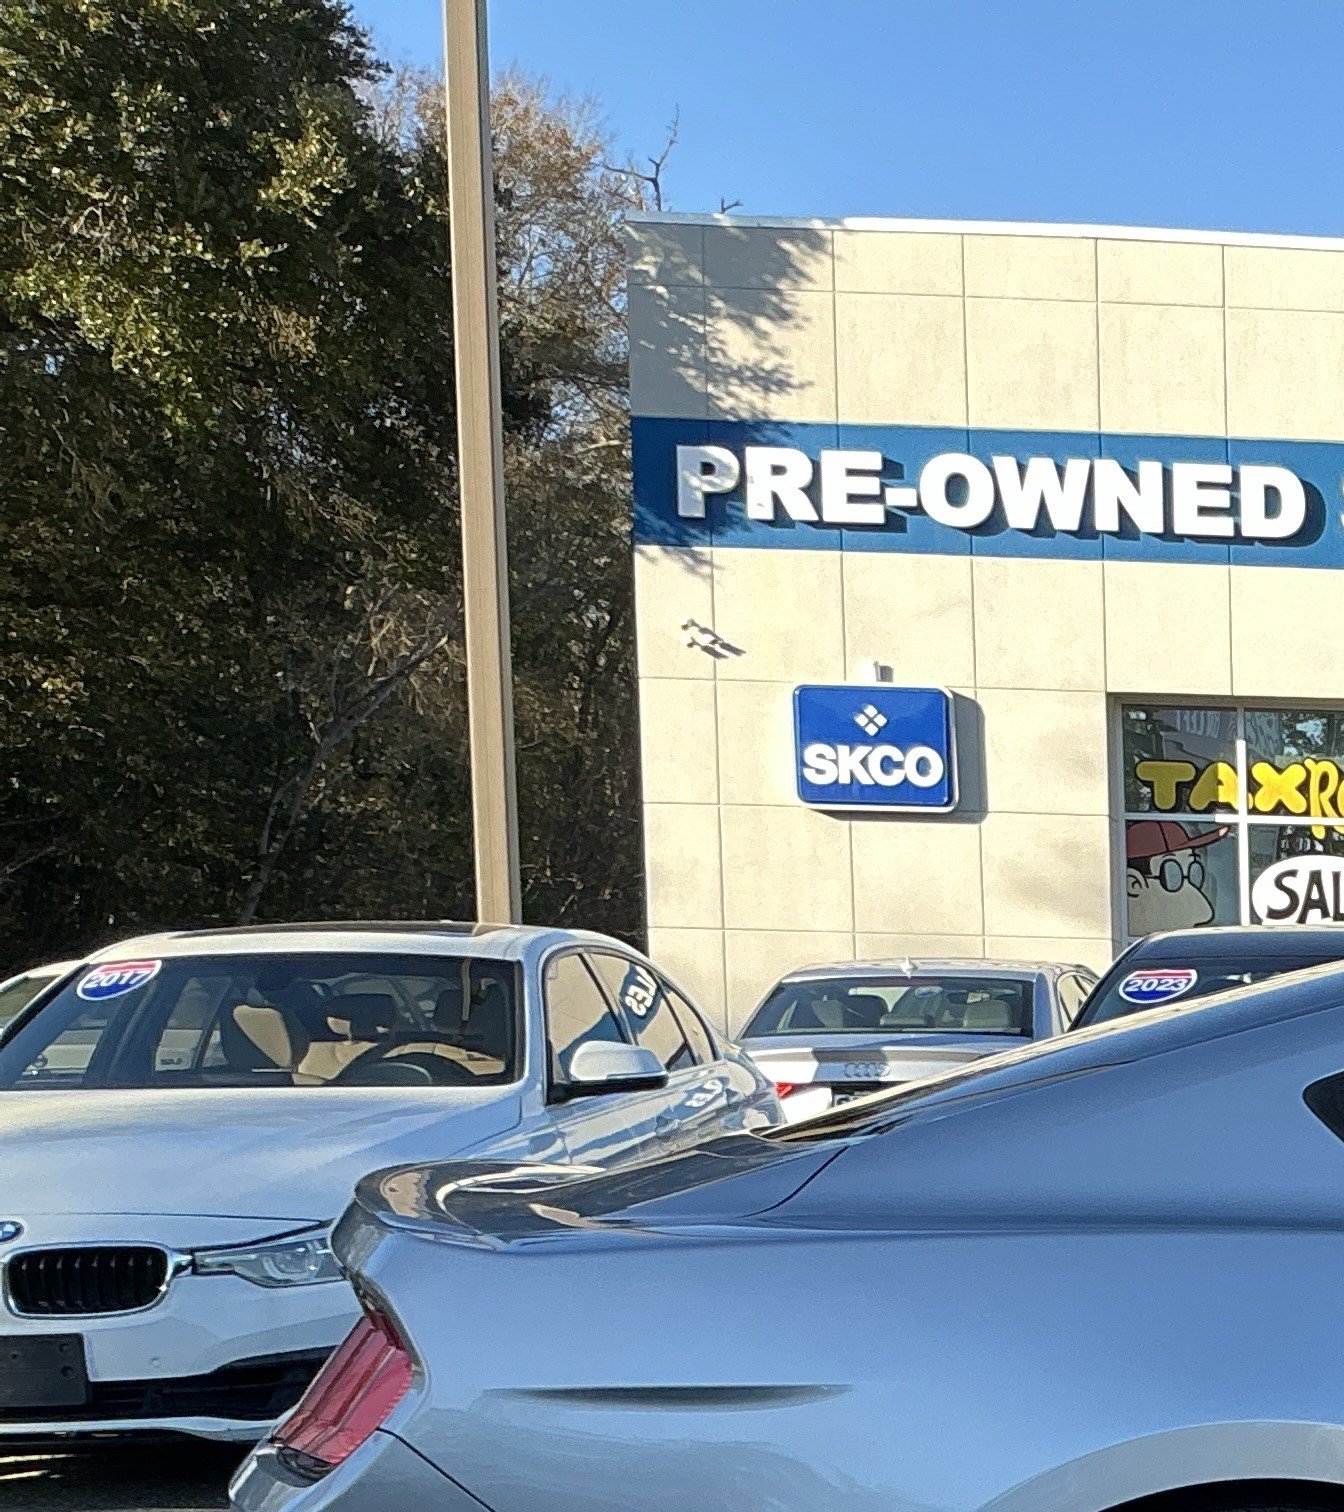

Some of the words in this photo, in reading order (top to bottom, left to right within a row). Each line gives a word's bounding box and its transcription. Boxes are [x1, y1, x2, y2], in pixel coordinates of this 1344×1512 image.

[676, 444, 1306, 538] PRE-OWNED
[803, 743, 944, 787] SKCO
[1135, 760, 1309, 814] TAX
[83, 969, 152, 988] 2017
[1124, 979, 1188, 991] 2023
